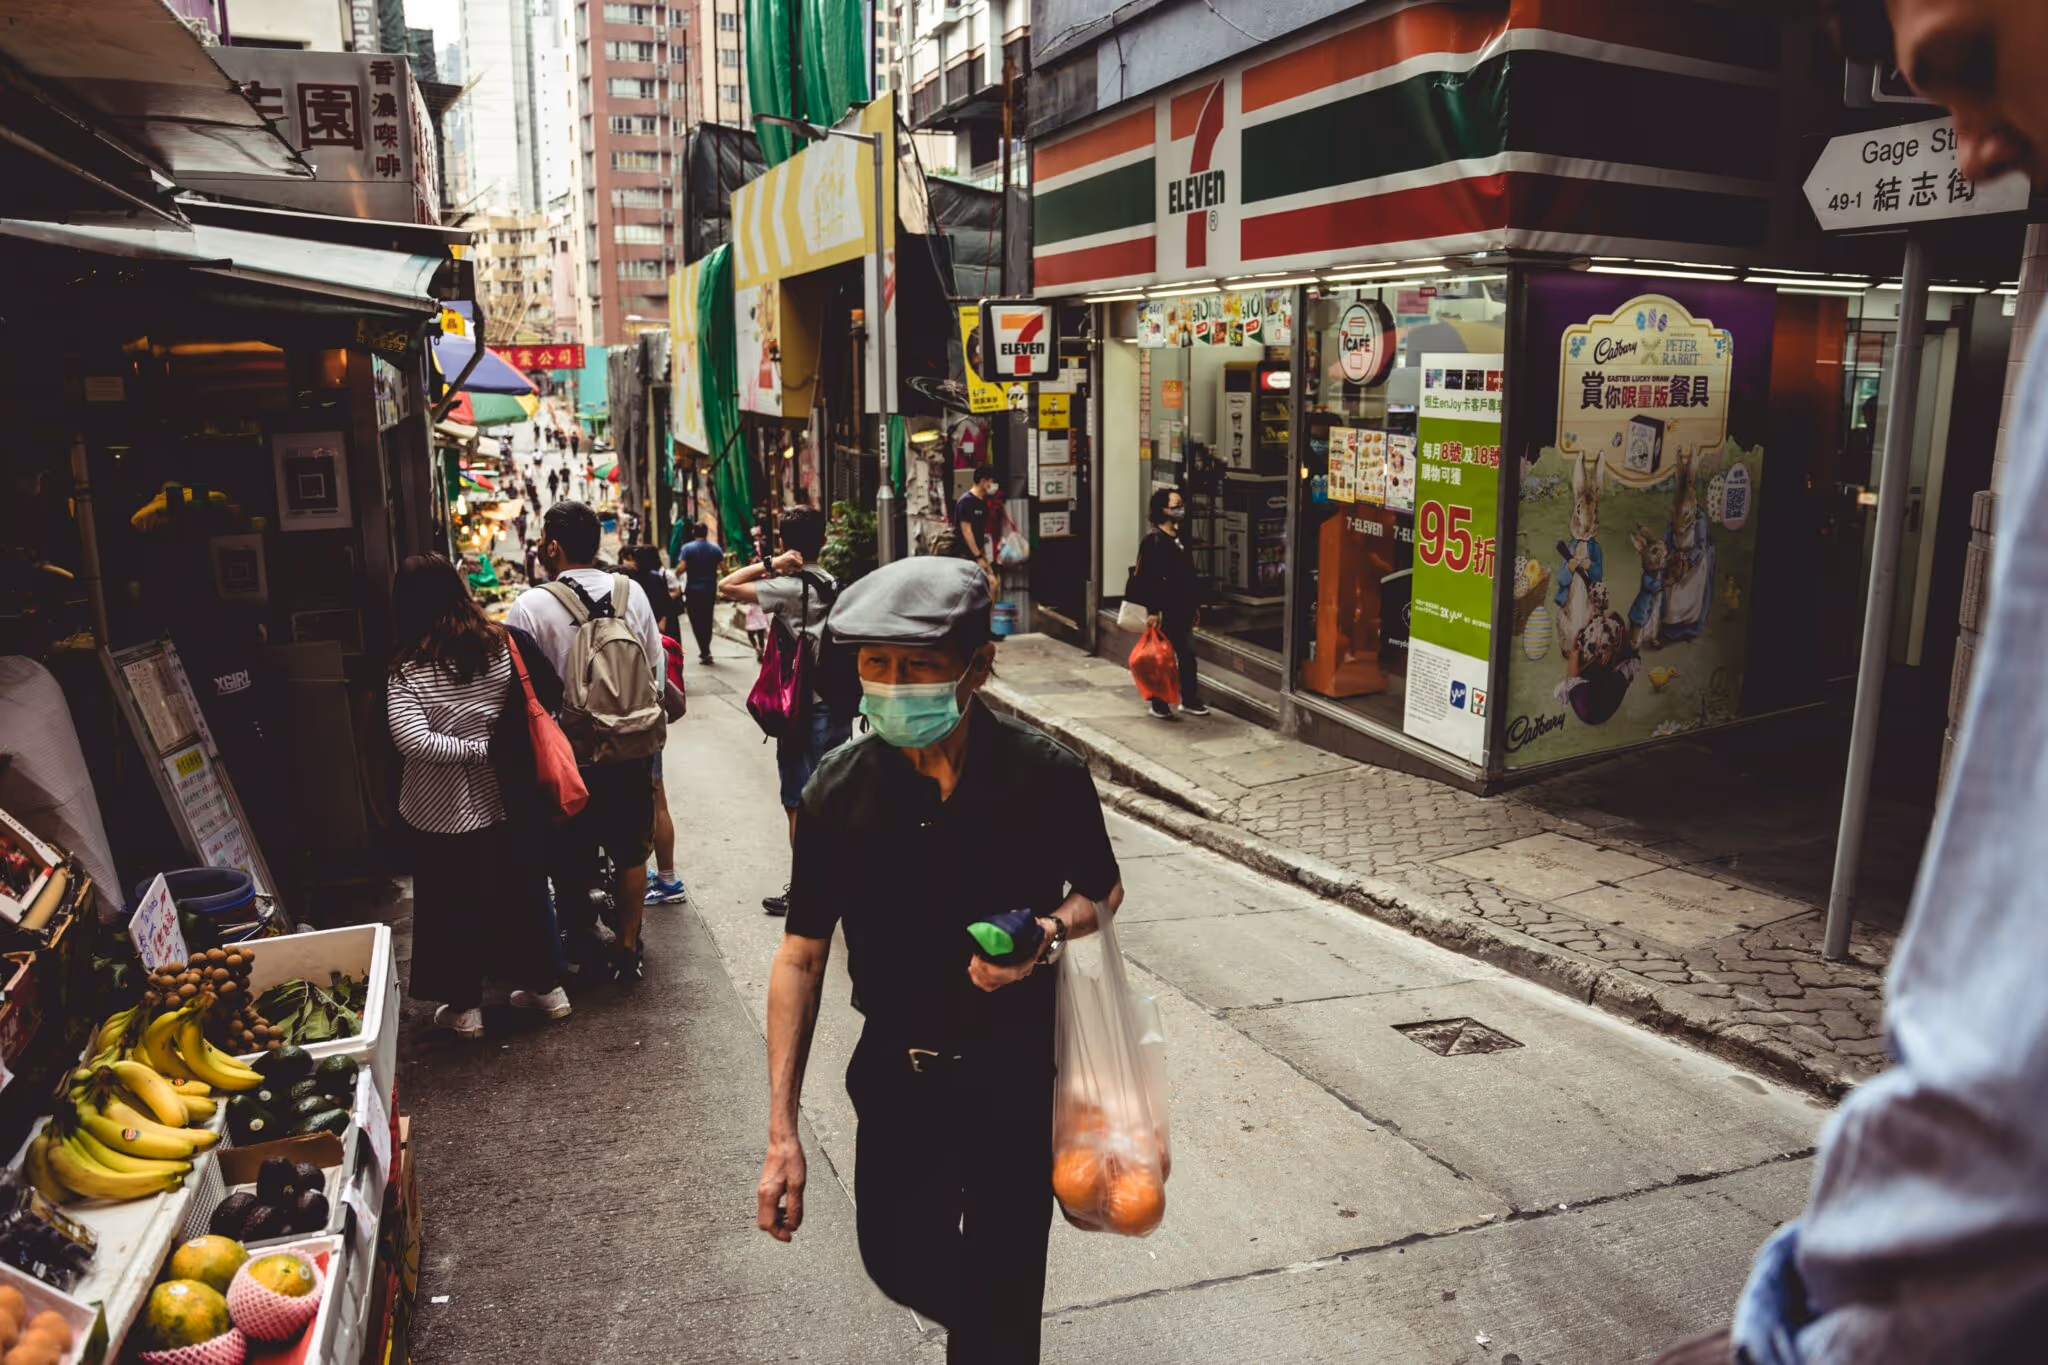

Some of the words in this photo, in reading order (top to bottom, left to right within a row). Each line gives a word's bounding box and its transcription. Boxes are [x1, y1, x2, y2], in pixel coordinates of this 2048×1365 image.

[1862, 139, 1919, 166] Gage
[1171, 79, 1224, 269] 7
[1828, 191, 1862, 211] 49-1
[1001, 313, 1044, 374] 7
[1594, 337, 1638, 365] Cadbury
[1665, 339, 1698, 352] PETER
[1662, 353, 1700, 366] RABBIT
[1580, 371, 1710, 410] 賞你限量版餐具
[1505, 711, 1565, 752] Cadbury
